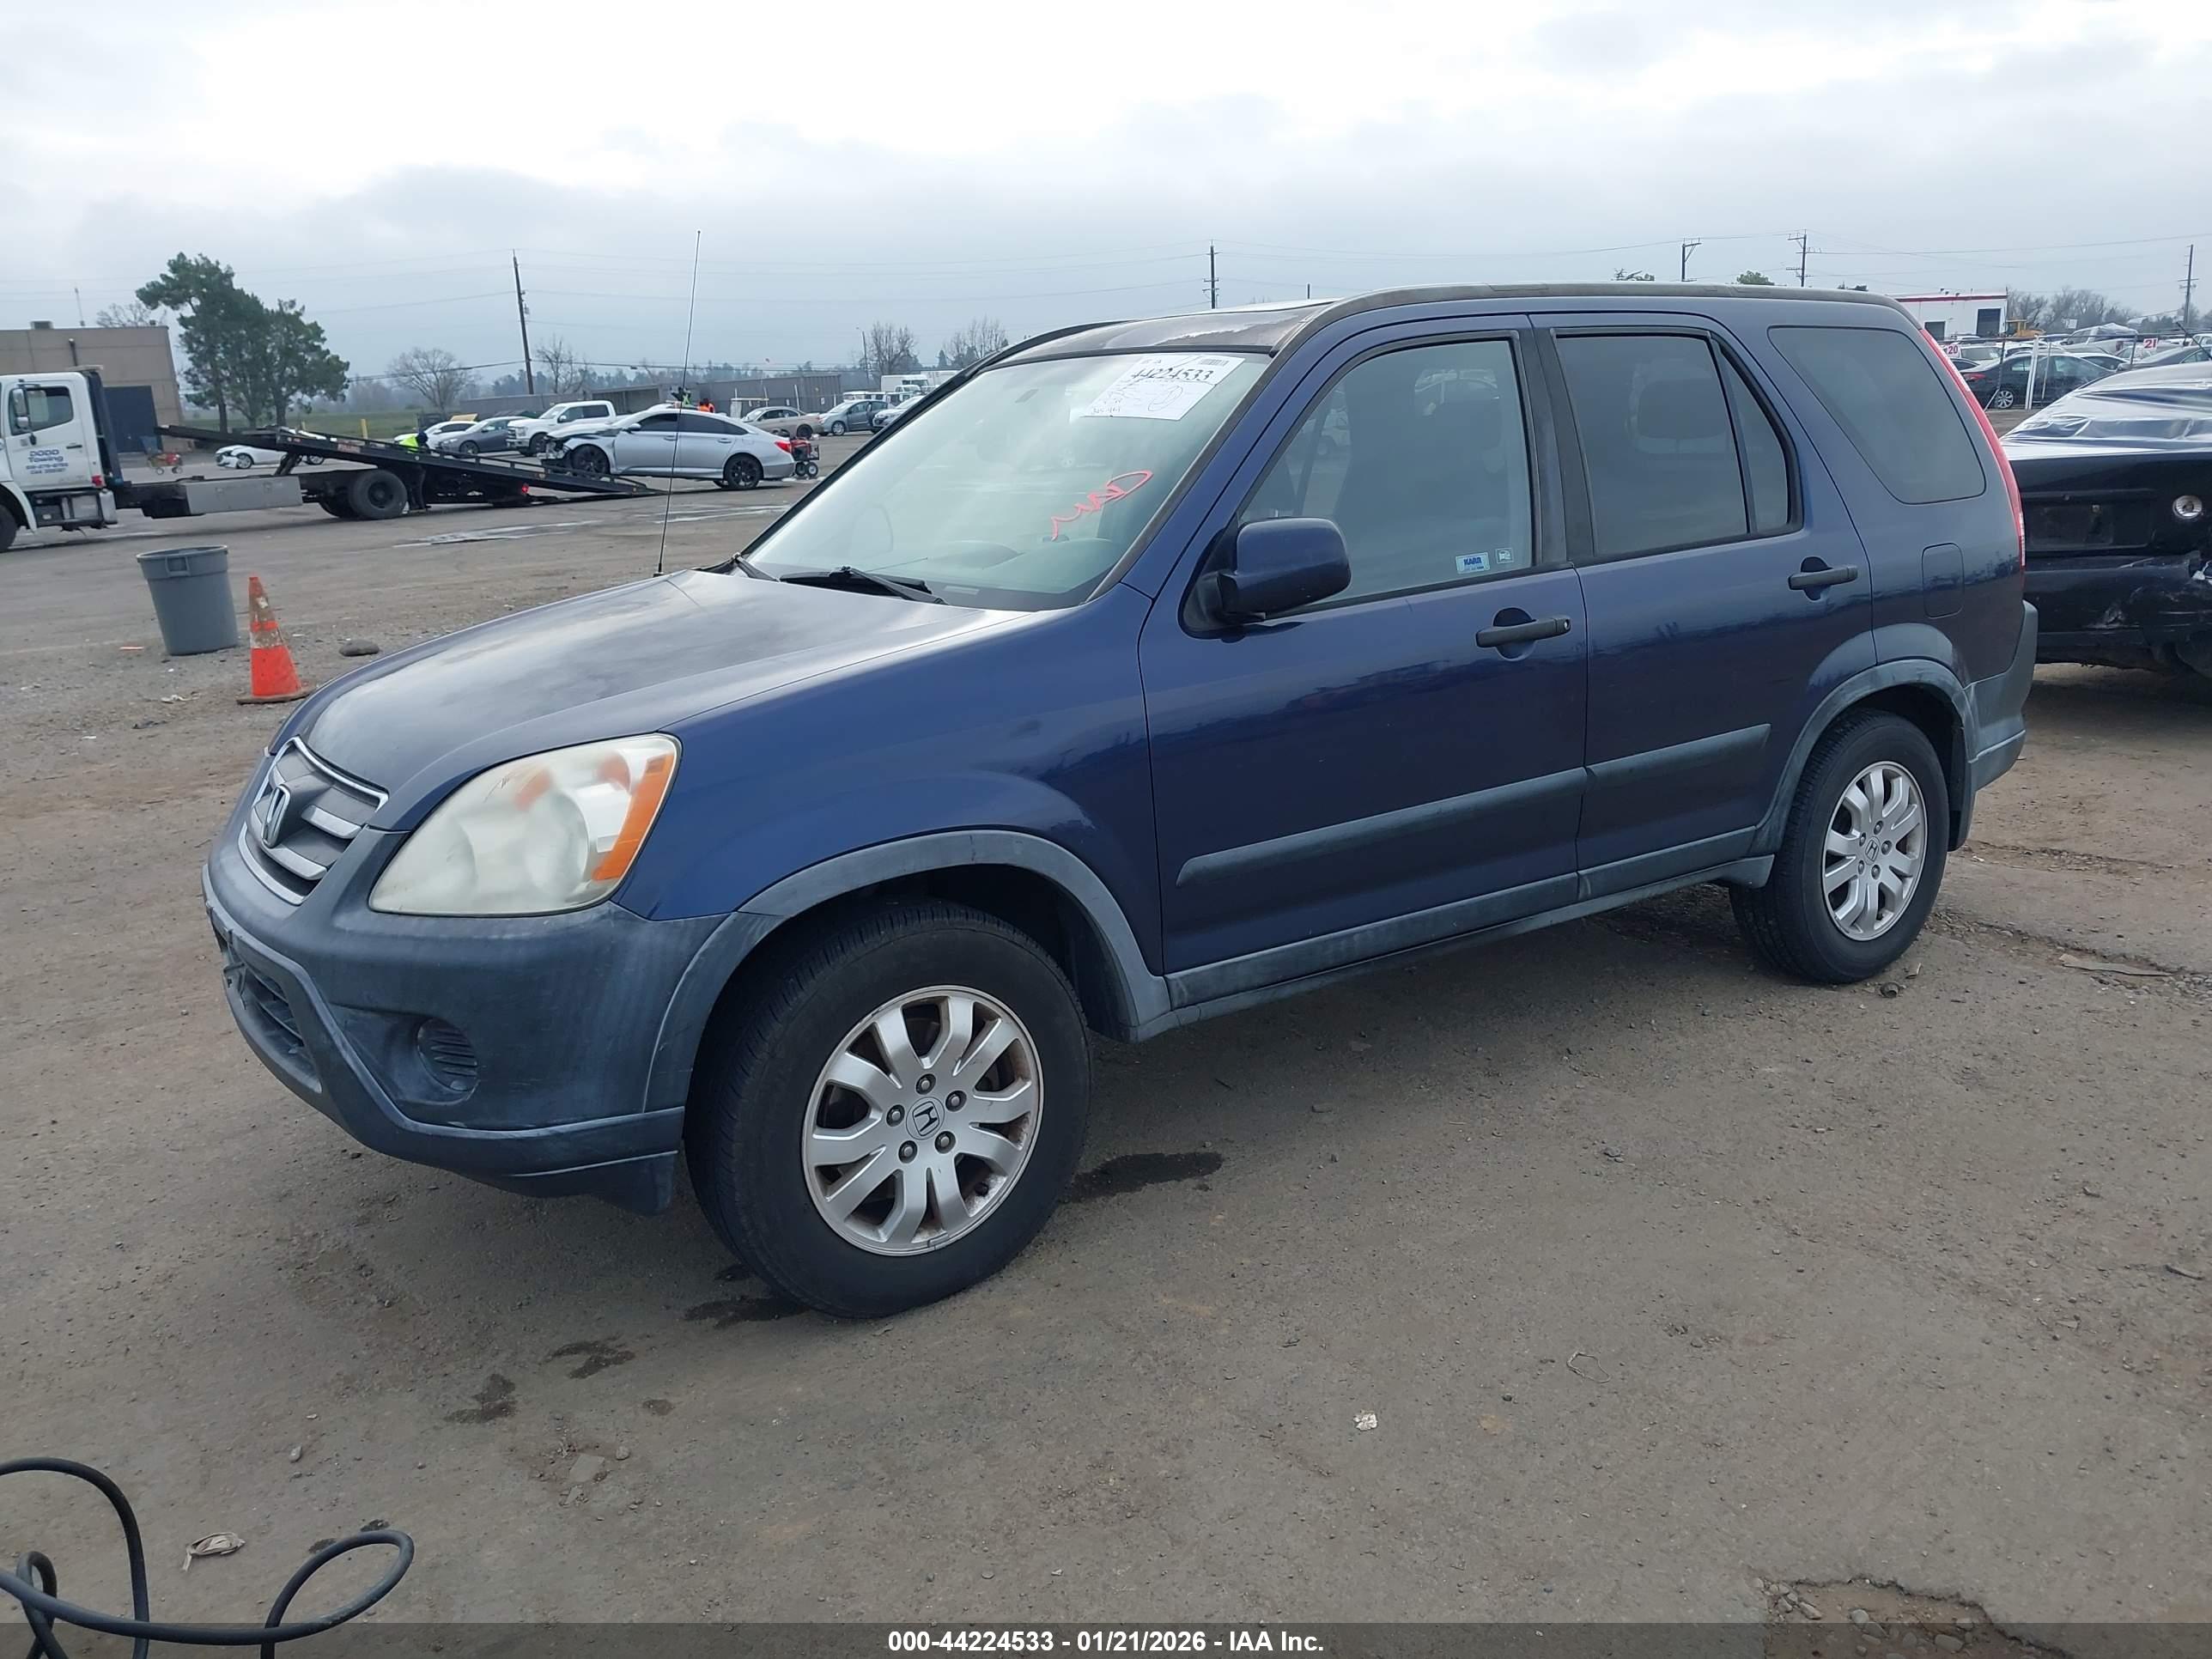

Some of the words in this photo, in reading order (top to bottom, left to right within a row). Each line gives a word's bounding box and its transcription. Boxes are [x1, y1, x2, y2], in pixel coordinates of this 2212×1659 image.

[2144, 339, 2156, 349] 21
[1948, 345, 1959, 355] 20
[1131, 368, 1213, 381] 44224533
